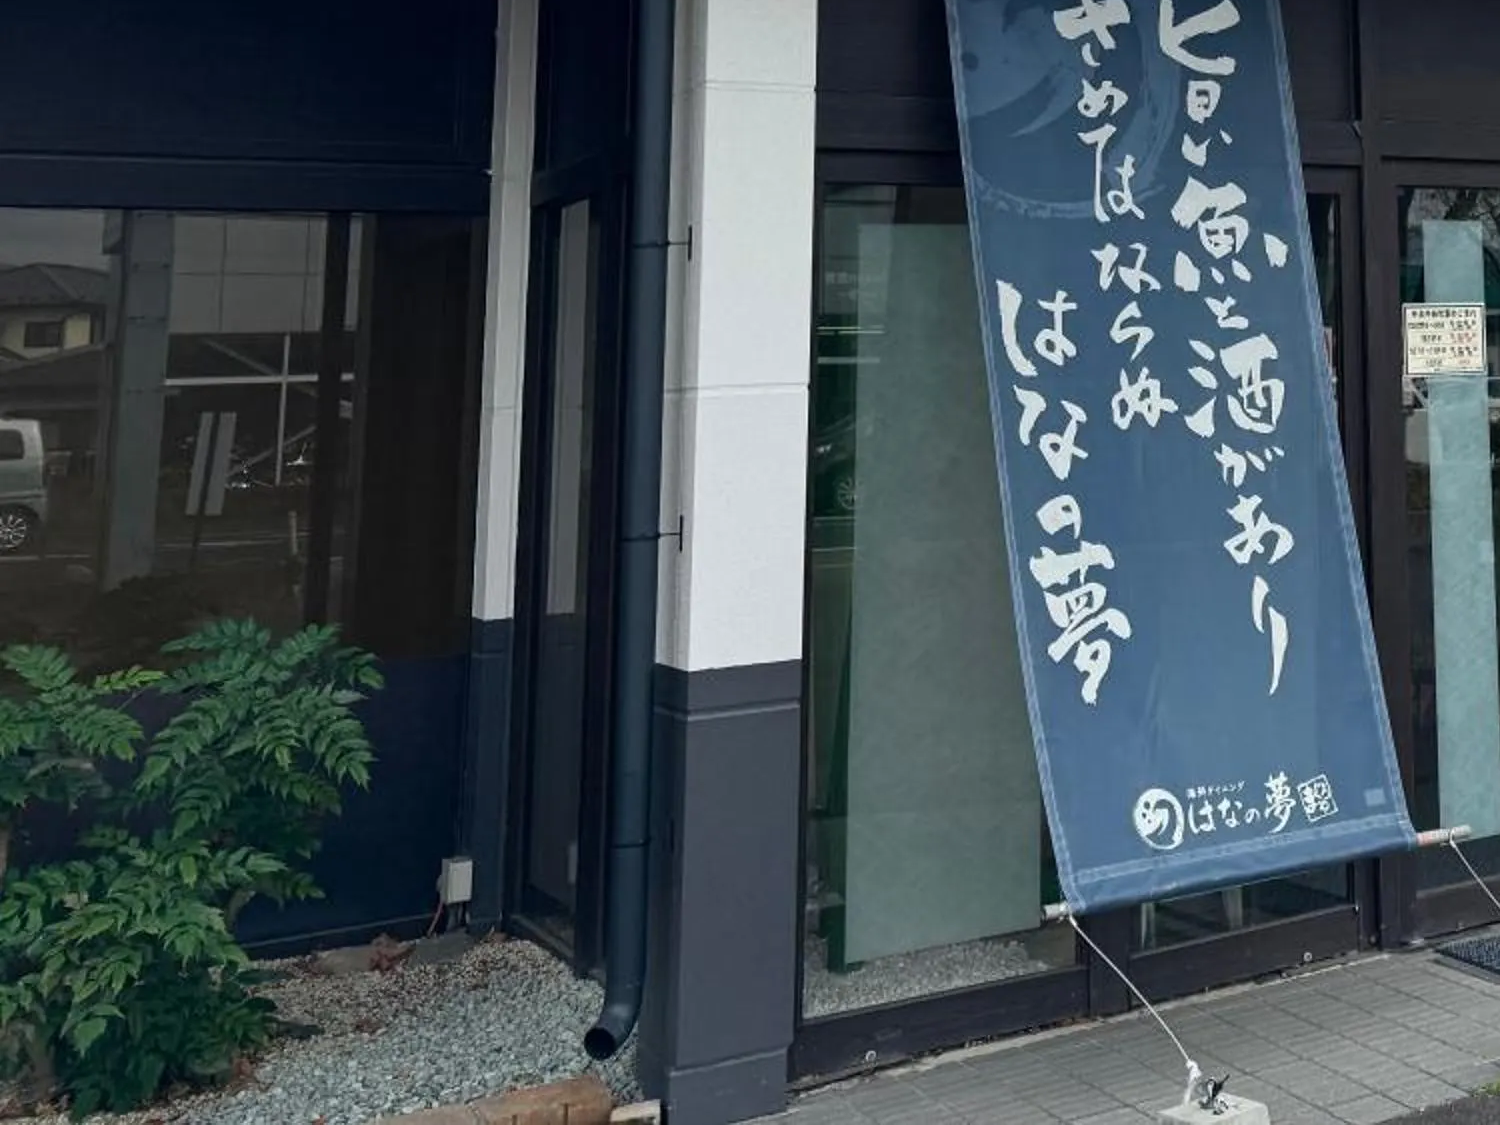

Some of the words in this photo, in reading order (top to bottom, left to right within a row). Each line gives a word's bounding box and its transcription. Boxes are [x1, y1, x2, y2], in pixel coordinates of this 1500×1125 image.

[996, 277, 1132, 706] はなの夢
[1187, 771, 1297, 833] はなの夢
